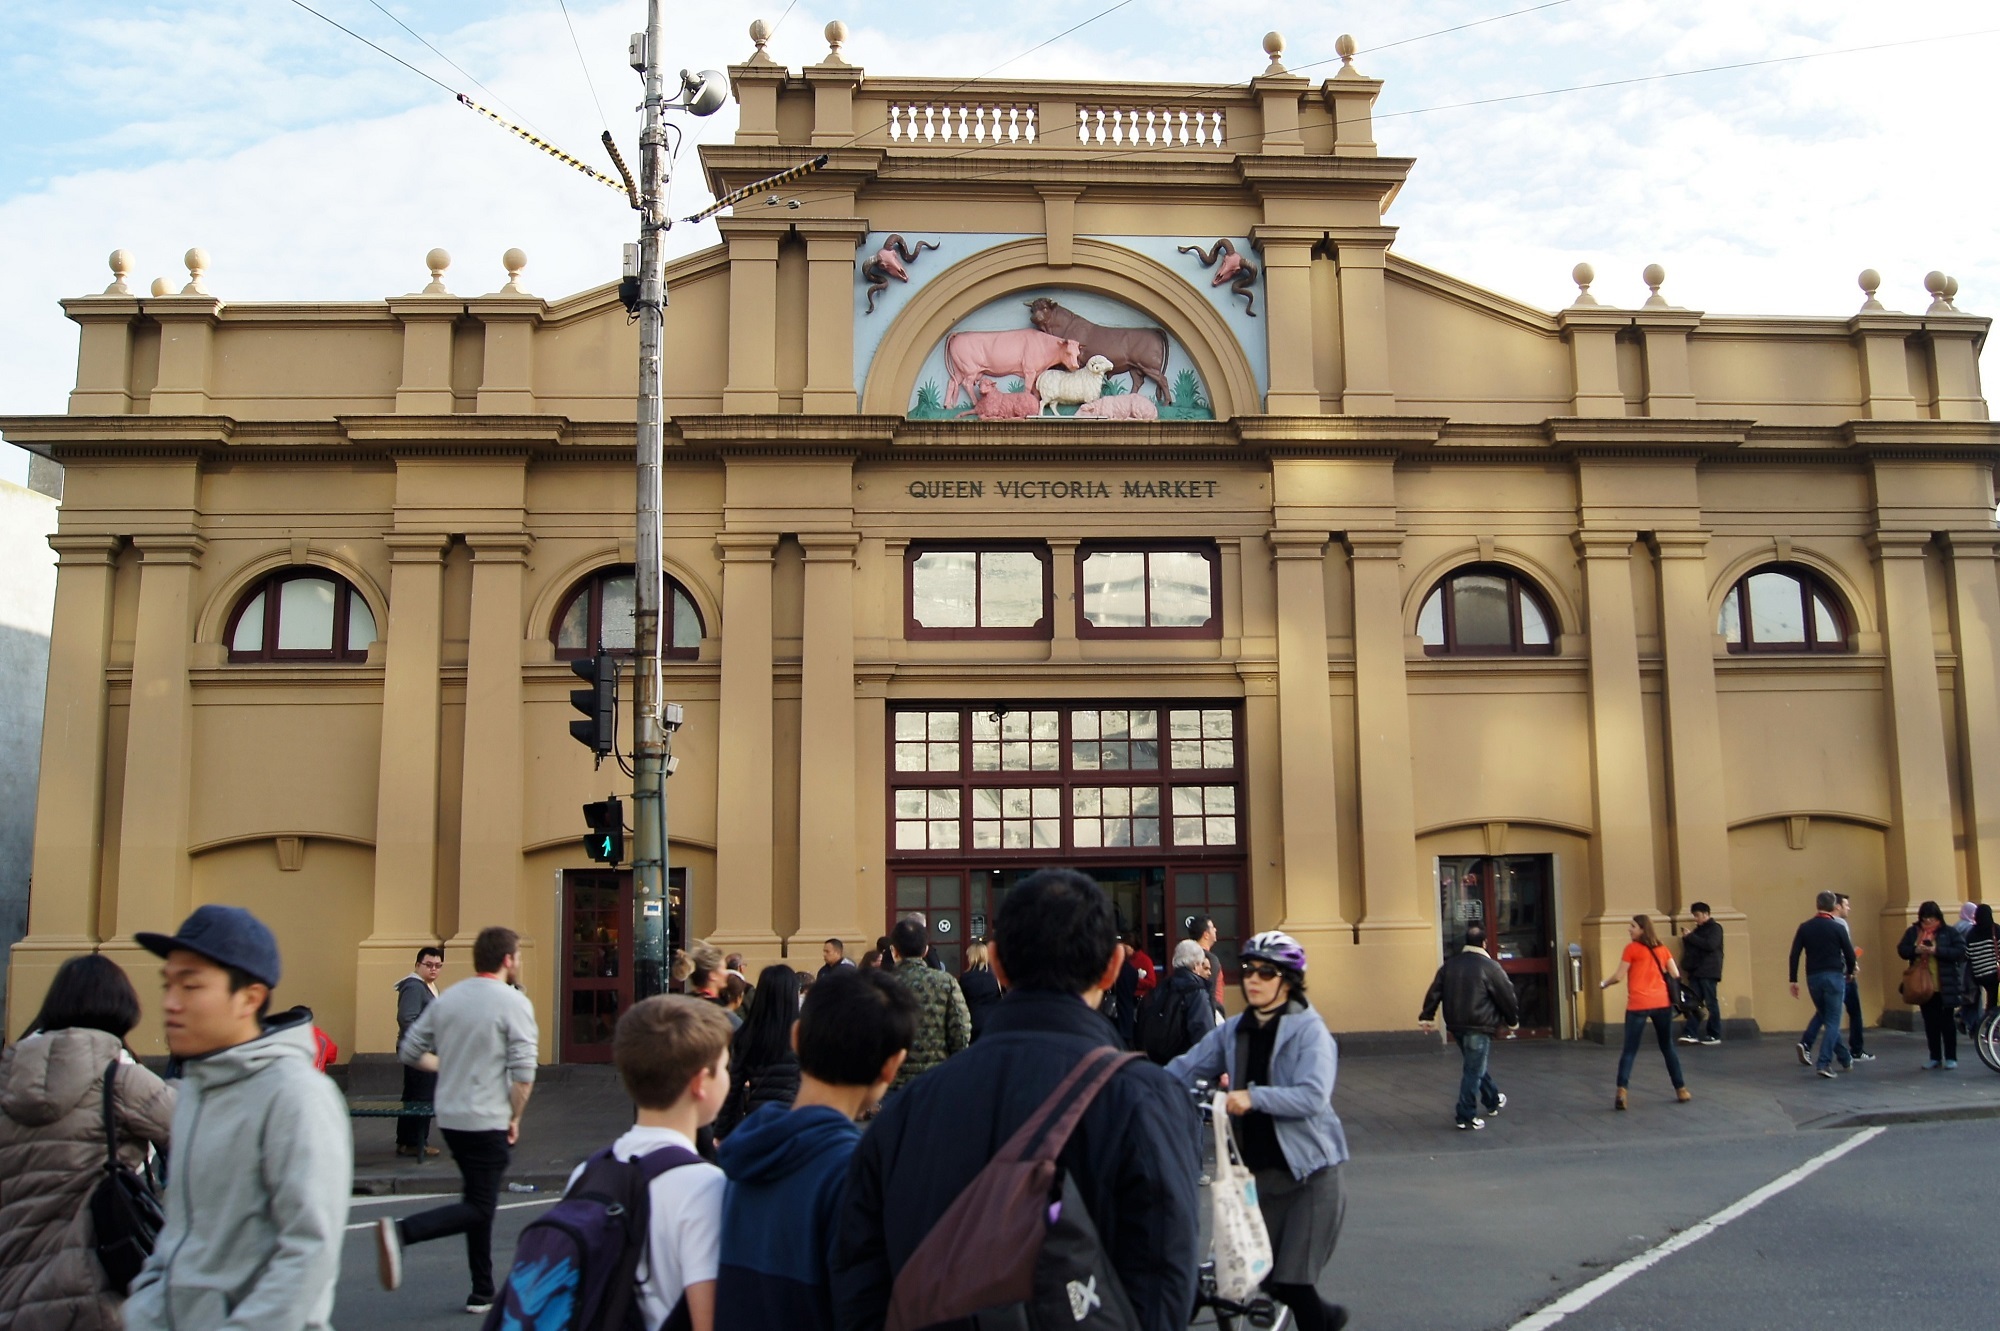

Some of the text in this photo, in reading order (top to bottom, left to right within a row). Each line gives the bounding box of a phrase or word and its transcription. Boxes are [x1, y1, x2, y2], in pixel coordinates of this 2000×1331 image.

[909, 480, 1217, 499] QUEEN VICTORIA MARKET
